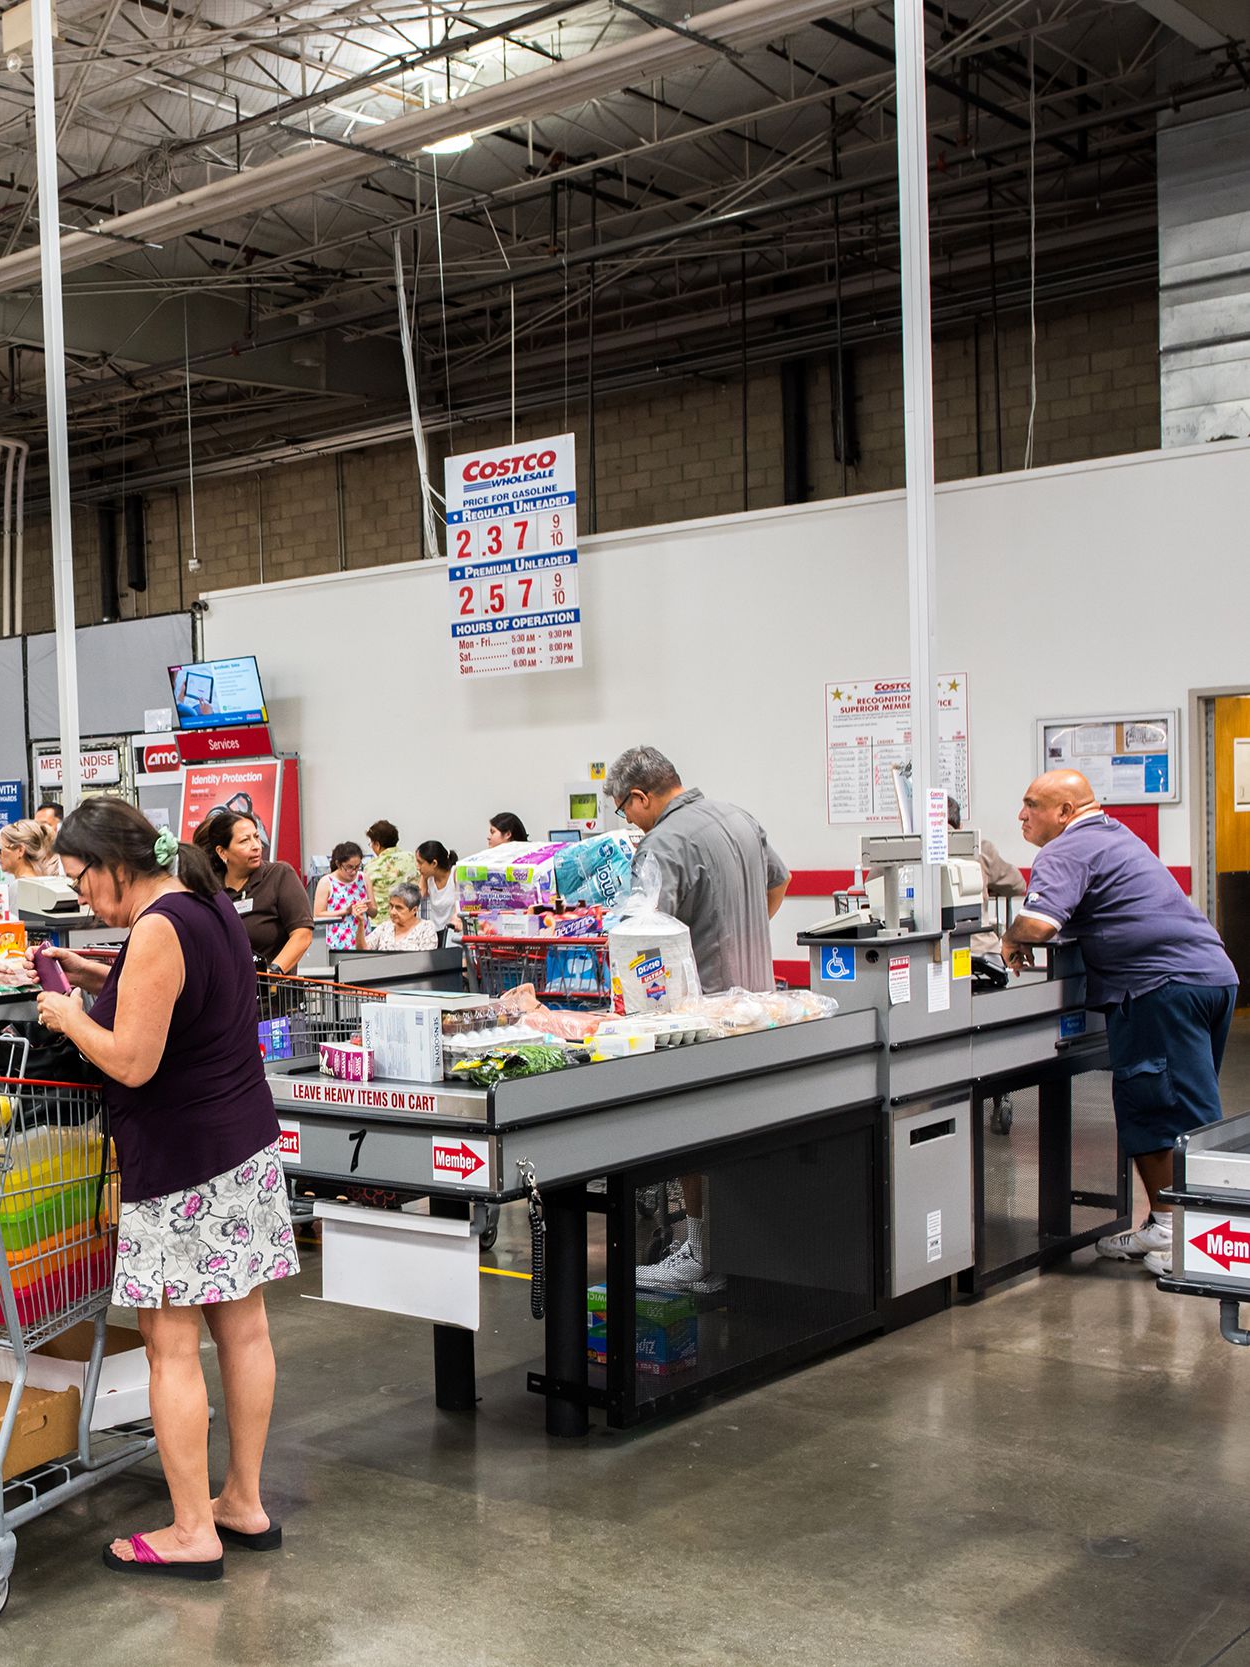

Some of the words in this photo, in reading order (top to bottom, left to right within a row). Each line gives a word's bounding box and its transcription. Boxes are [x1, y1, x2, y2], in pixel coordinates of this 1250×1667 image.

[462, 450, 557, 483] COSTCO
[491, 468, 554, 488] WHOLESALE
[462, 496, 489, 508] PRICE
[491, 492, 510, 503] FOR
[512, 484, 558, 499] GASOLINE
[462, 506, 510, 523] REGULAR
[513, 495, 570, 512] UNLEADED
[464, 564, 511, 579] PREMIUM
[514, 555, 571, 572] UNLEADED
[456, 620, 494, 635] HOURS
[496, 618, 510, 630] OF
[512, 611, 575, 629] OPERATION
[459, 640, 474, 650] Mon
[511, 634, 525, 643] 5:30
[526, 634, 535, 642] AM
[548, 629, 562, 639] 9:30
[563, 629, 572, 638] PM
[511, 647, 525, 656] 6:00
[526, 647, 536, 655] AM
[563, 642, 573, 651] PM
[513, 659, 527, 668] 6:00
[527, 659, 537, 667] AM
[564, 655, 574, 664] PM
[840, 705, 879, 714] SUPERIOR
[208, 738, 240, 750] Services
[41, 754, 114, 770] MERNDISE
[147, 751, 179, 766] amc
[191, 774, 221, 786] Identity
[222, 772, 262, 784] Protection
[644, 970, 663, 981] ULTRA
[433, 1016, 441, 1067] SENSODYNE
[293, 1084, 321, 1101] LEAVE
[324, 1087, 355, 1104] HEAVY
[358, 1090, 388, 1107] ITEMS
[391, 1093, 405, 1109] ON
[408, 1095, 436, 1112] CART
[348, 1128, 367, 1173] 7
[435, 1147, 477, 1170] Member
[1207, 1233, 1250, 1258] Mem
